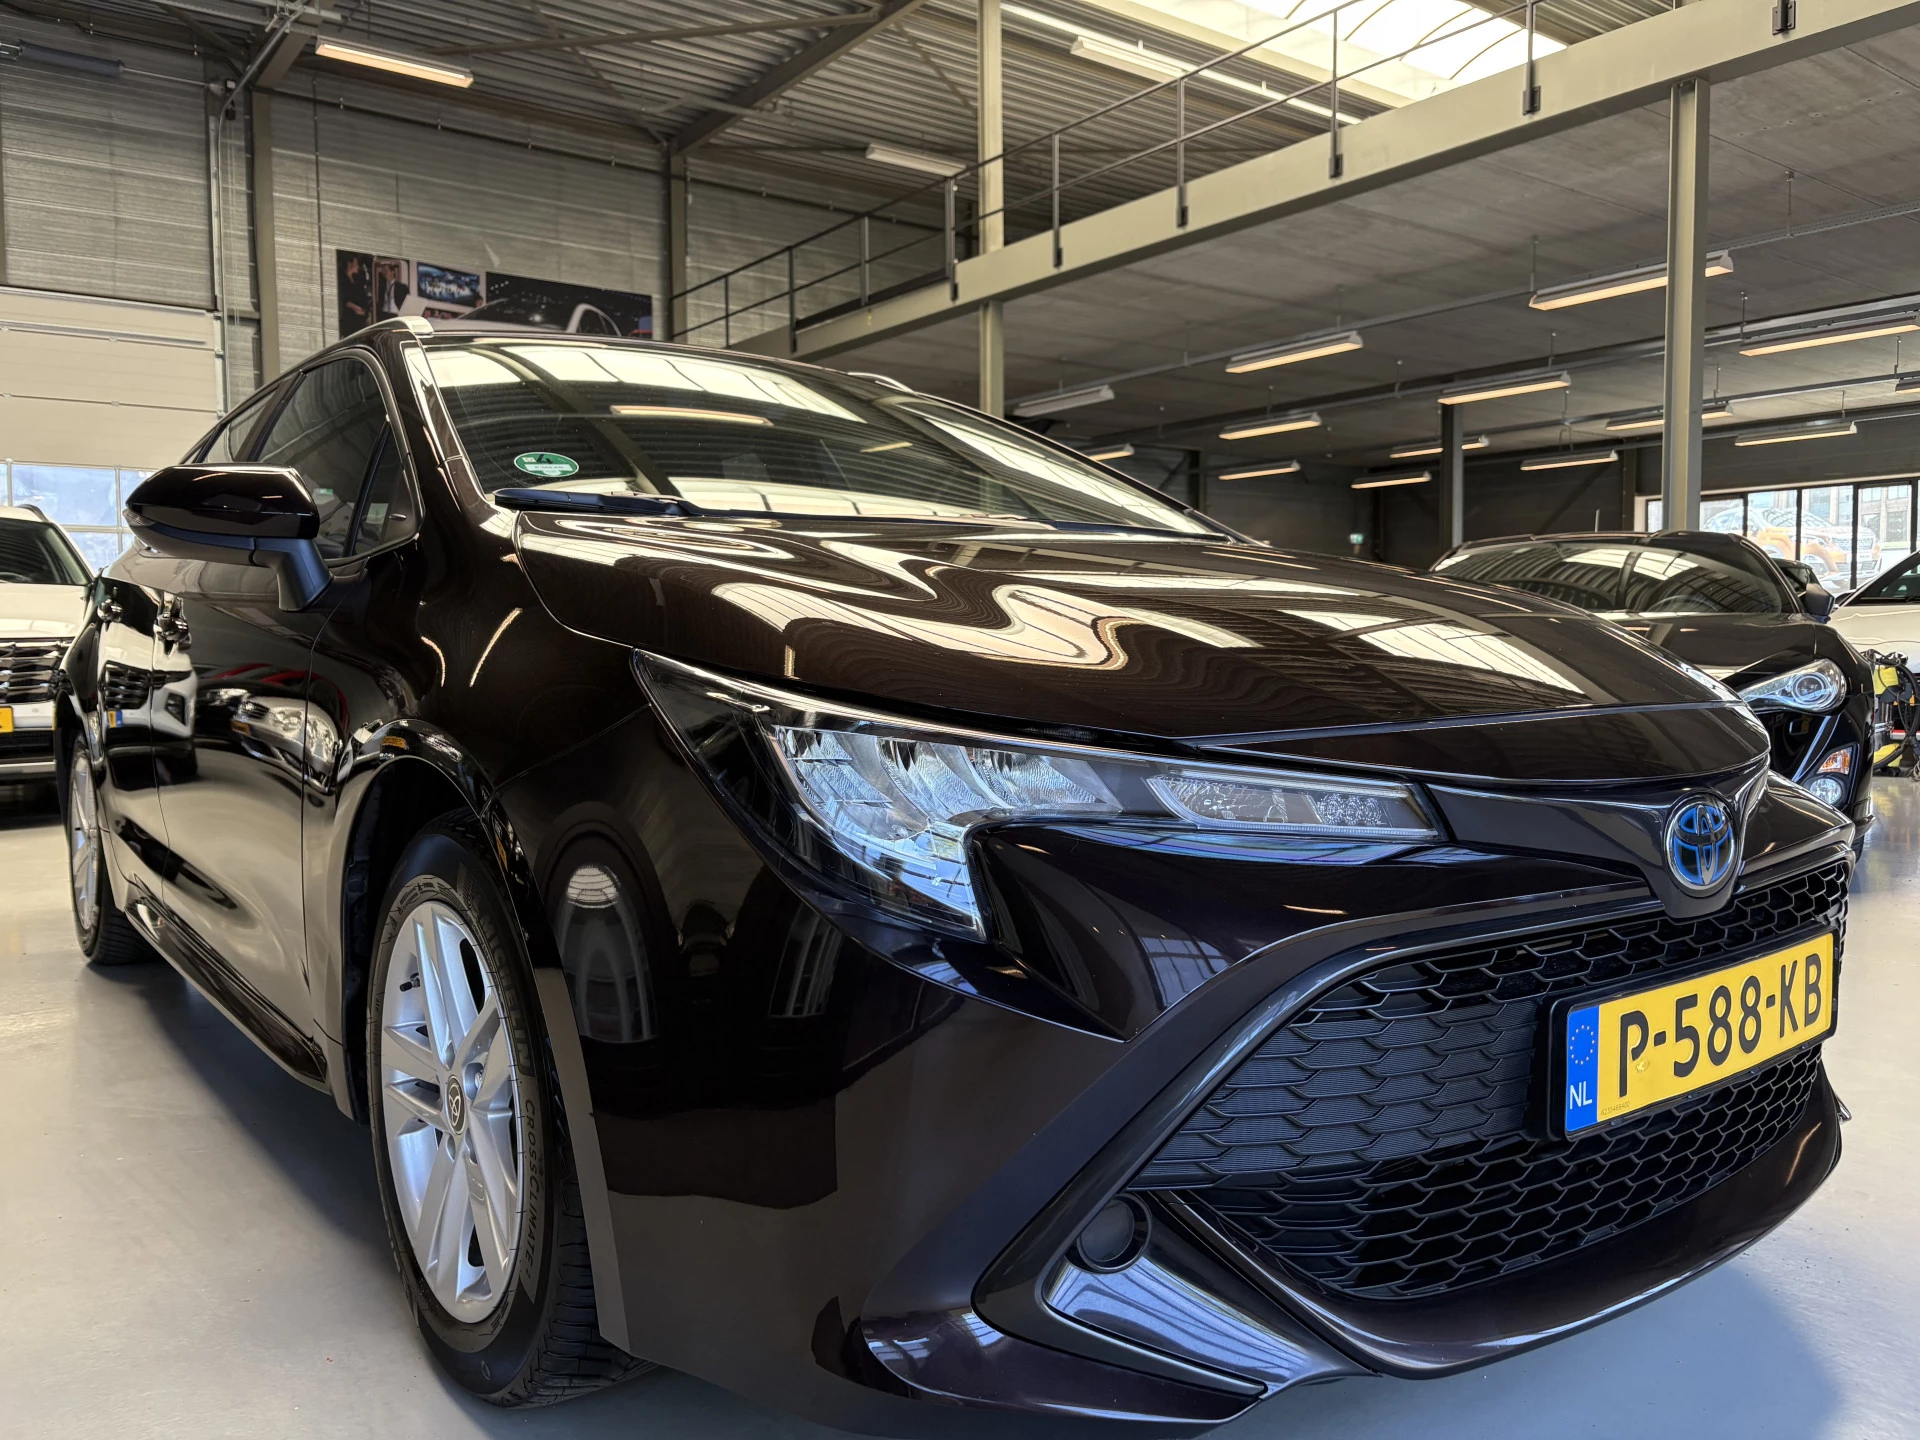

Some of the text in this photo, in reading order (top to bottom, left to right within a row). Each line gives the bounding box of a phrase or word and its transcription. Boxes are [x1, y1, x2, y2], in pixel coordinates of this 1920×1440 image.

[536, 454, 553, 464] 4
[482, 915, 531, 1065] MICHELIN
[1619, 953, 1822, 1098] P-588-KB
[1569, 1081, 1593, 1110] NL
